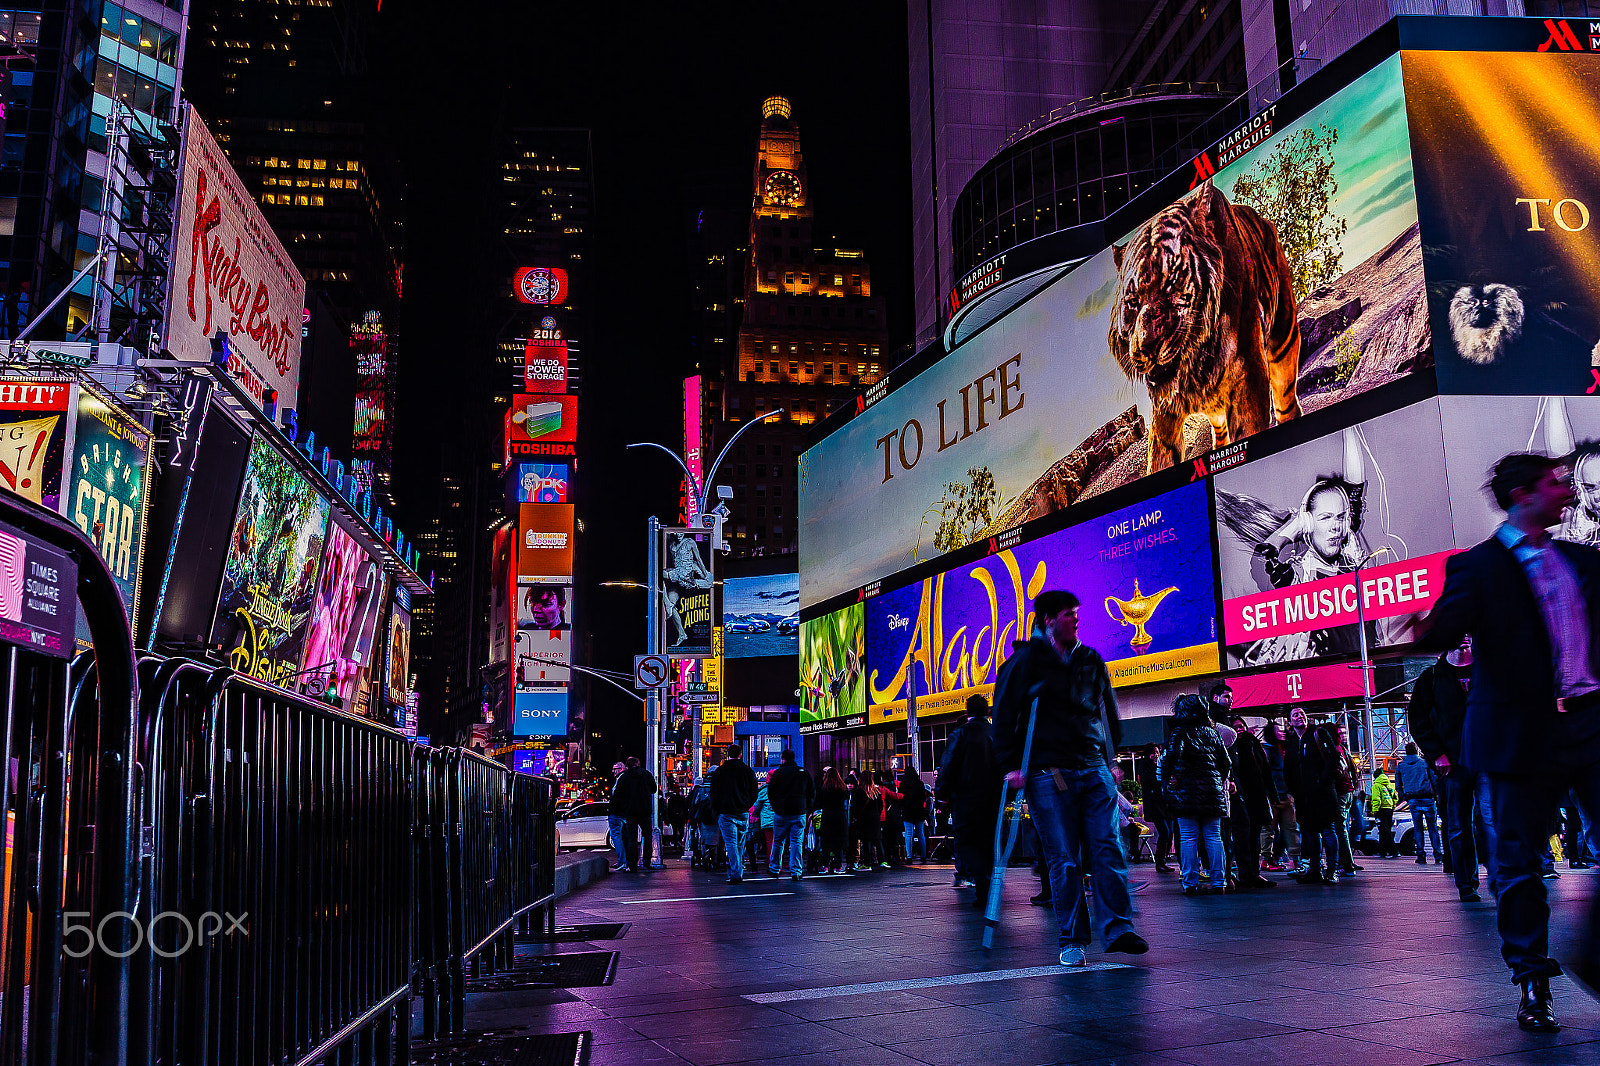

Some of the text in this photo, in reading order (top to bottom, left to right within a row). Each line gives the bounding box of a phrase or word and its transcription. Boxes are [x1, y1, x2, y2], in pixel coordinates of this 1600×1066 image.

[1218, 104, 1277, 153] MARRIOTT
[1219, 124, 1271, 167] MARQUIS
[1515, 198, 1590, 232] TO
[962, 254, 1007, 289] MARRIOTT
[962, 271, 1000, 302] MARQUIS
[526, 338, 567, 347] TOSHIBA
[534, 329, 561, 339] 2016
[42, 350, 87, 366] LAMAR
[527, 365, 565, 374] POWER
[866, 376, 890, 397] MARRIOTT
[876, 352, 1025, 485] TO LIFE
[511, 443, 575, 455] TOSHIBA
[1210, 441, 1249, 462] MARRIOTT
[80, 442, 138, 501] BRIGHT
[1210, 453, 1245, 472] MARQUIS
[336, 459, 421, 573] BROADWAY
[1107, 510, 1164, 539] ONE LAMP.
[75, 478, 134, 580] STAR
[1098, 527, 1179, 563] THREE WISHES.
[31, 561, 58, 583] TIMES
[26, 578, 60, 602] SQUARE
[1242, 568, 1430, 632] SET MUSIC FREE
[679, 593, 709, 614] SHUFFLE
[684, 607, 710, 629] ALONG
[1114, 657, 1192, 679] AladdinTheMusical.com
[521, 709, 561, 717] SONY
